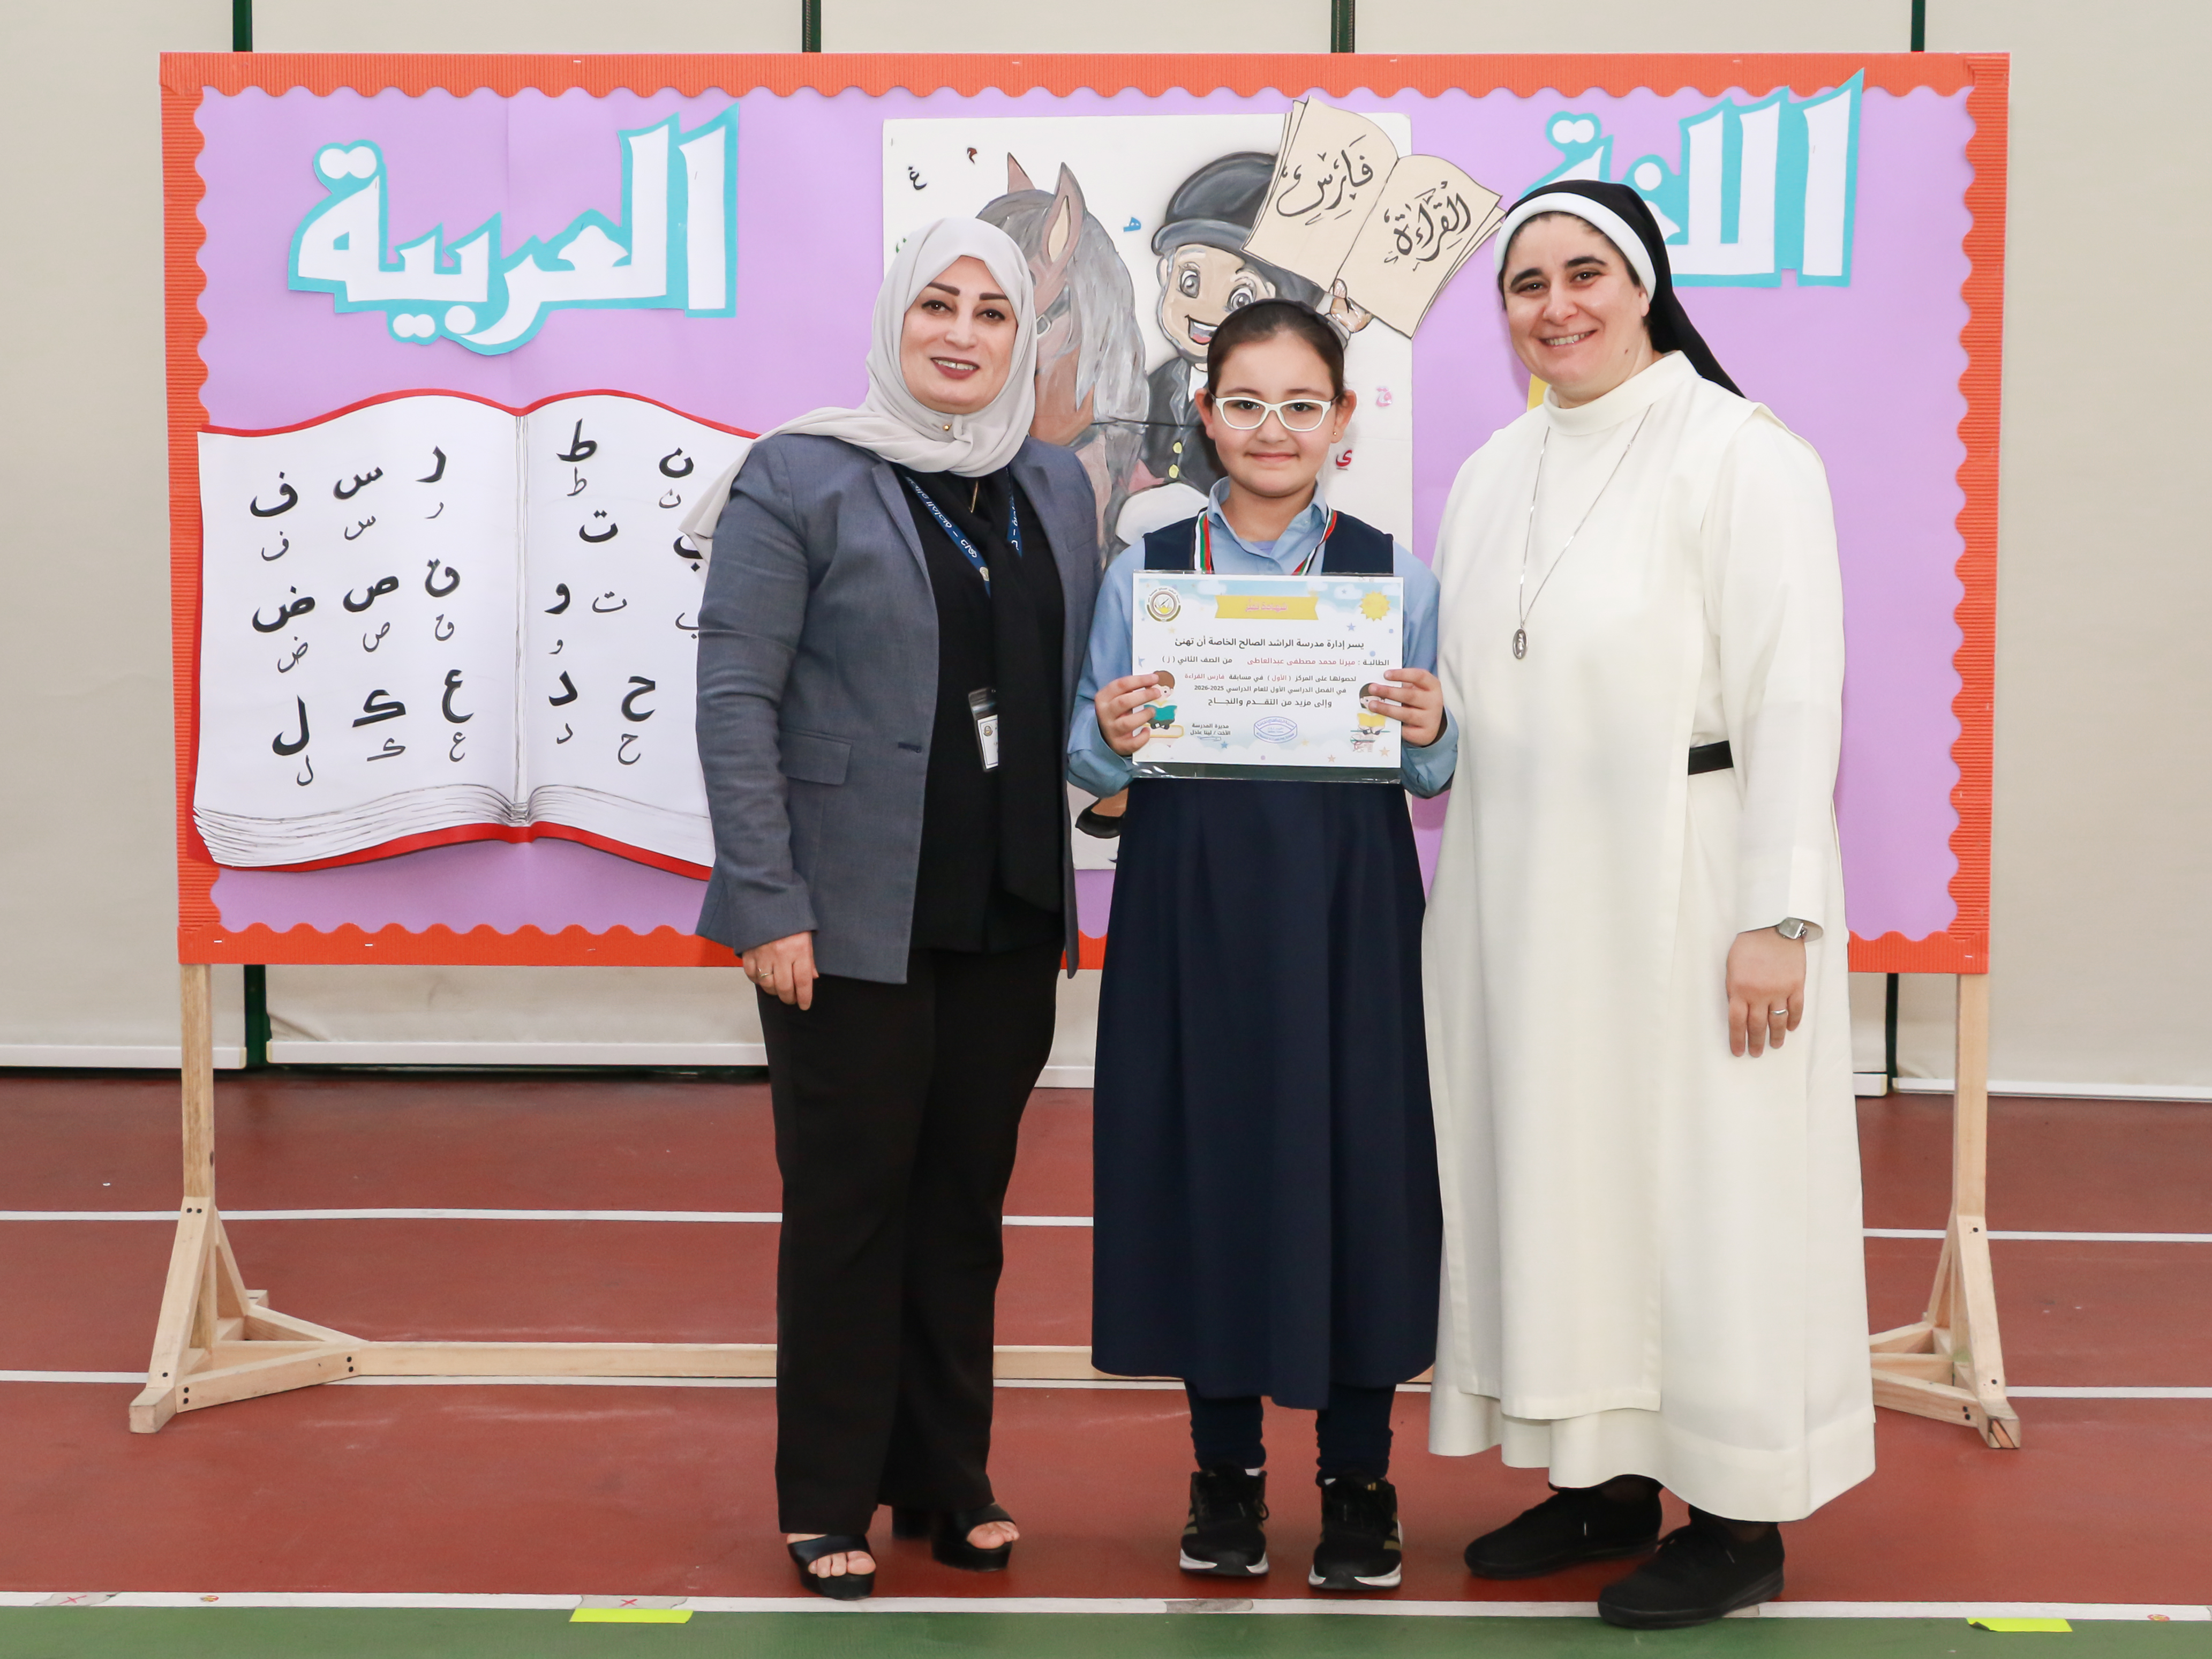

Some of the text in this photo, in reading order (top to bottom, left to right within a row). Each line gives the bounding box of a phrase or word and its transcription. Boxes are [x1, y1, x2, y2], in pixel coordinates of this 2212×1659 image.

[298, 125, 725, 344] العربية
[1197, 636, 1206, 647] أن
[1208, 637, 1236, 645] الخاصة
[1239, 639, 1265, 649] الصالح
[1268, 640, 1293, 648] الراشد
[1297, 639, 1324, 648] مدرسة
[1327, 640, 1344, 650] إدارة
[1178, 656, 1198, 665] الثاني
[1314, 700, 1331, 708] وإلى
